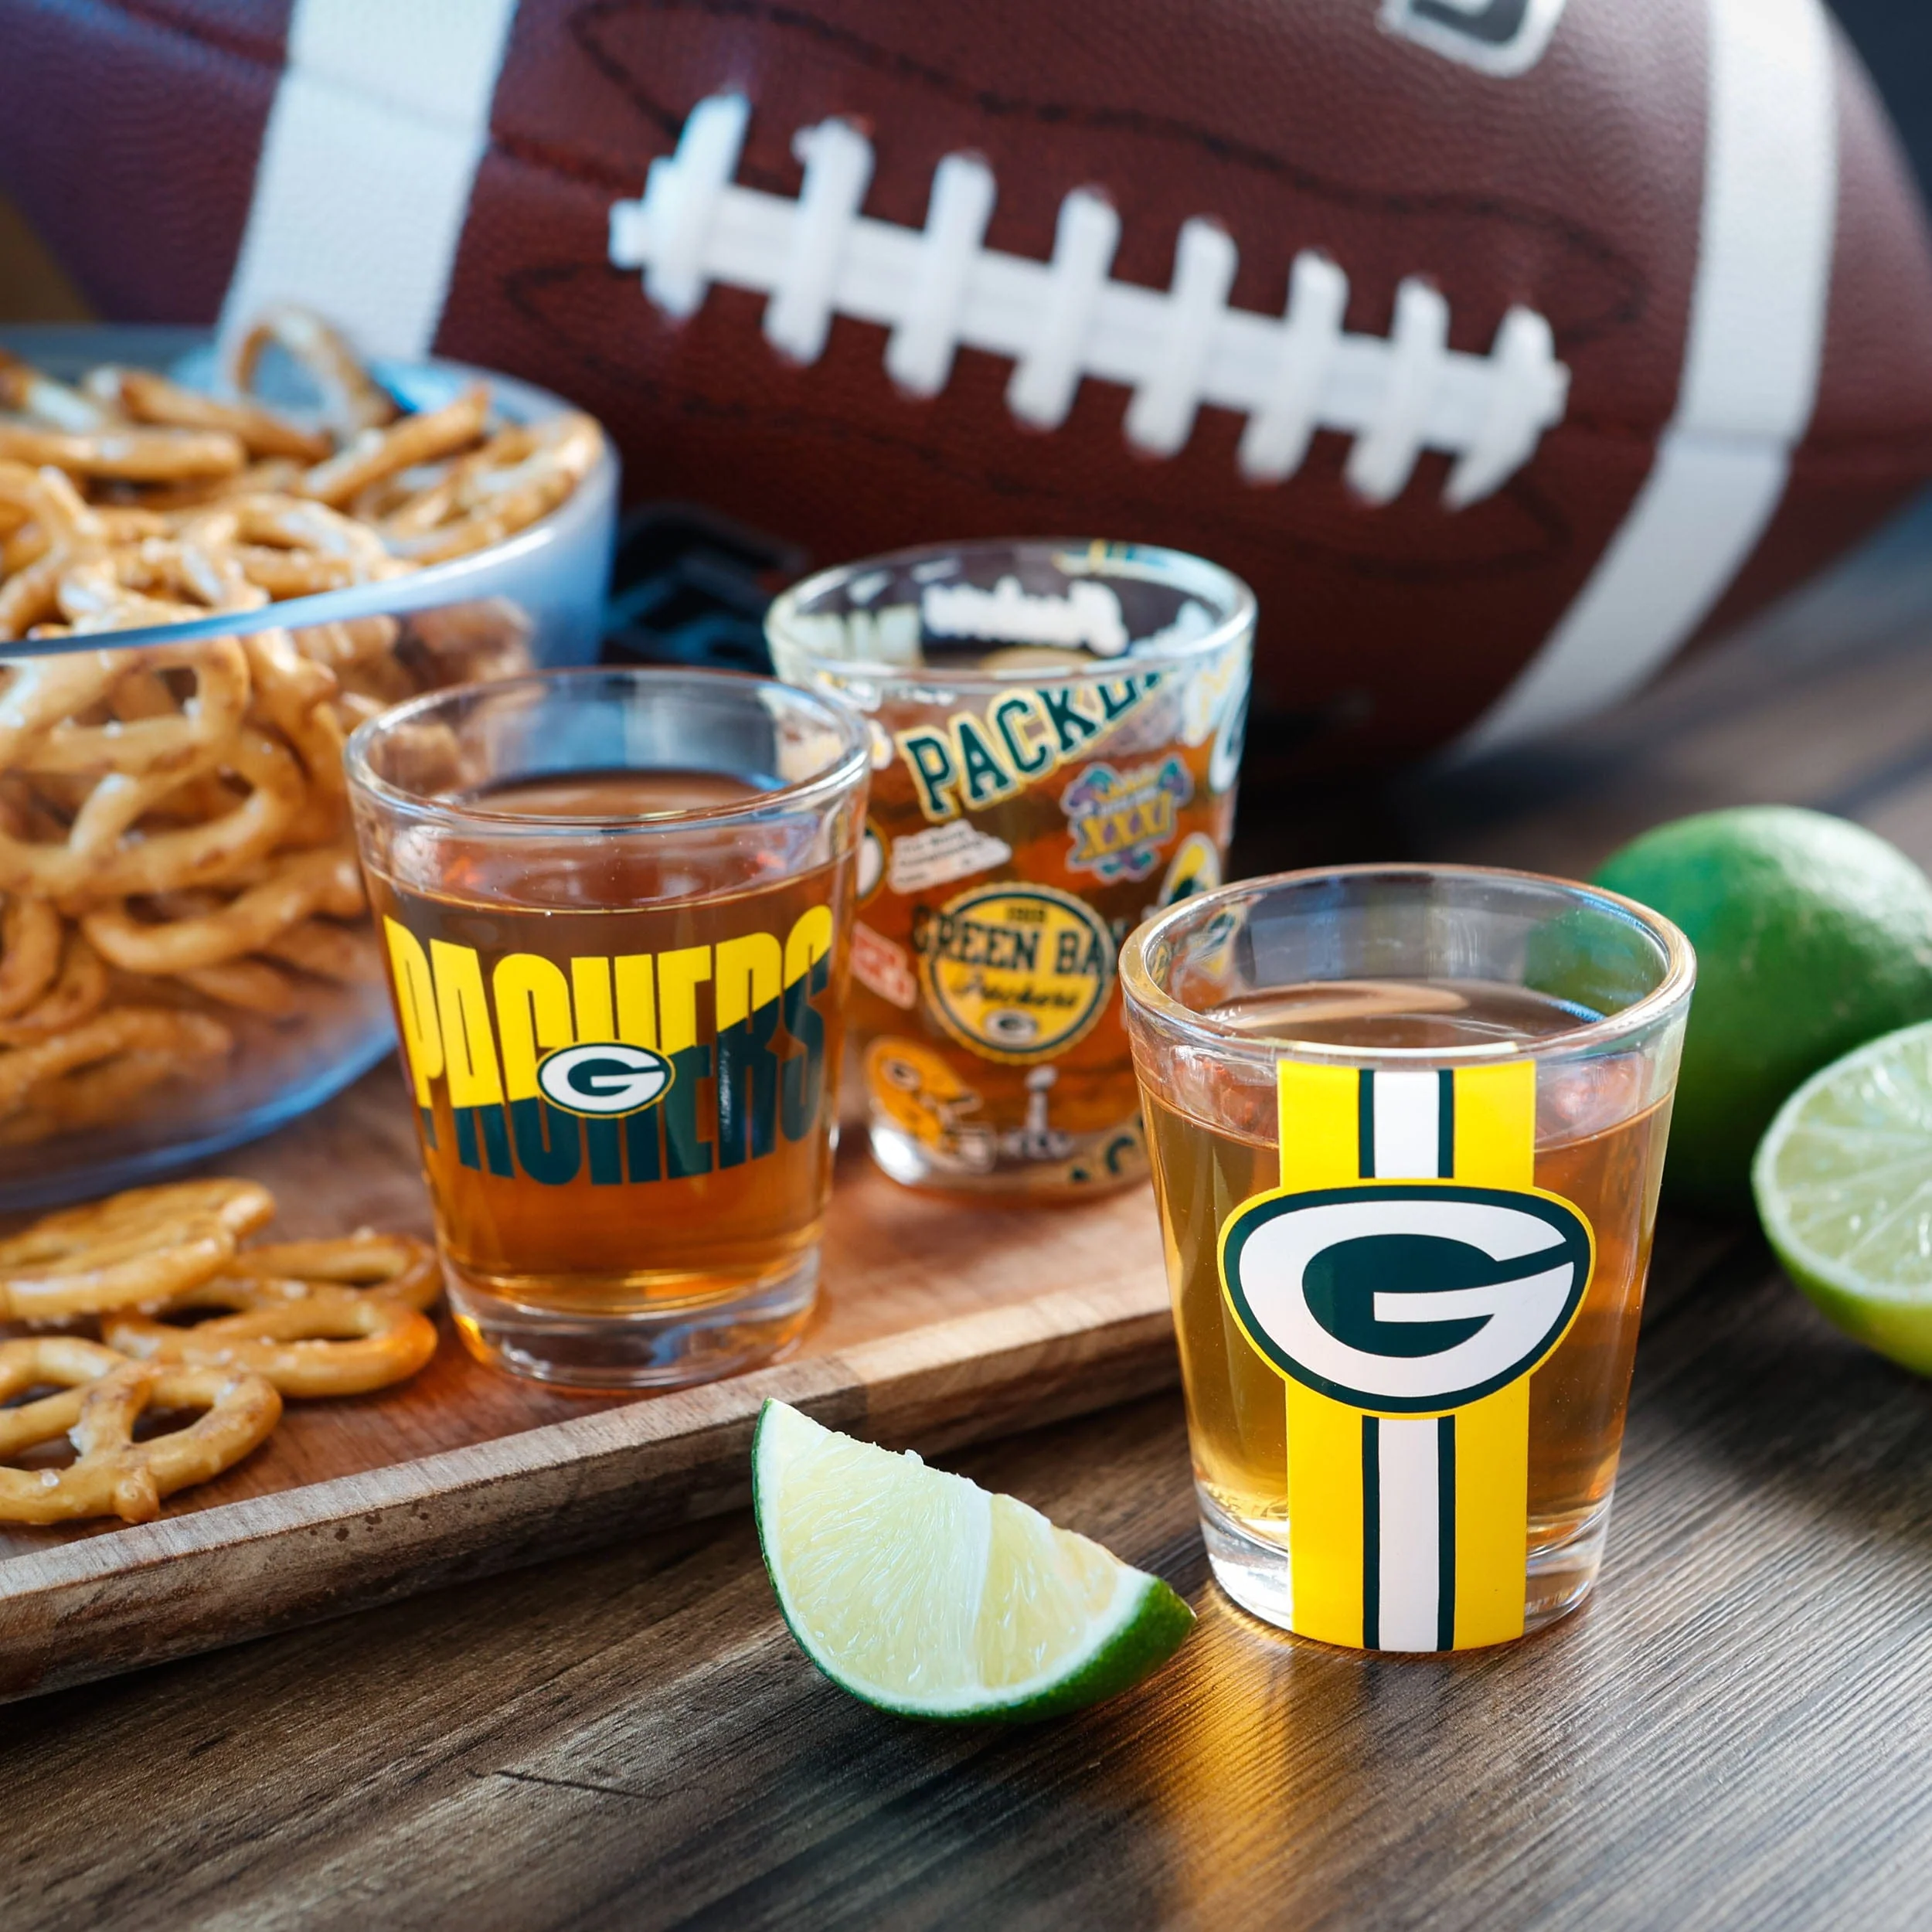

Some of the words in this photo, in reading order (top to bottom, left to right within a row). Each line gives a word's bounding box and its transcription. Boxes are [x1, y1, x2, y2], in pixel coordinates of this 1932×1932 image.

[911, 905, 1040, 972] GREEN
[383, 905, 833, 1186] PACKERS
[541, 1043, 666, 1112] G
[1238, 1200, 1574, 1397] G
